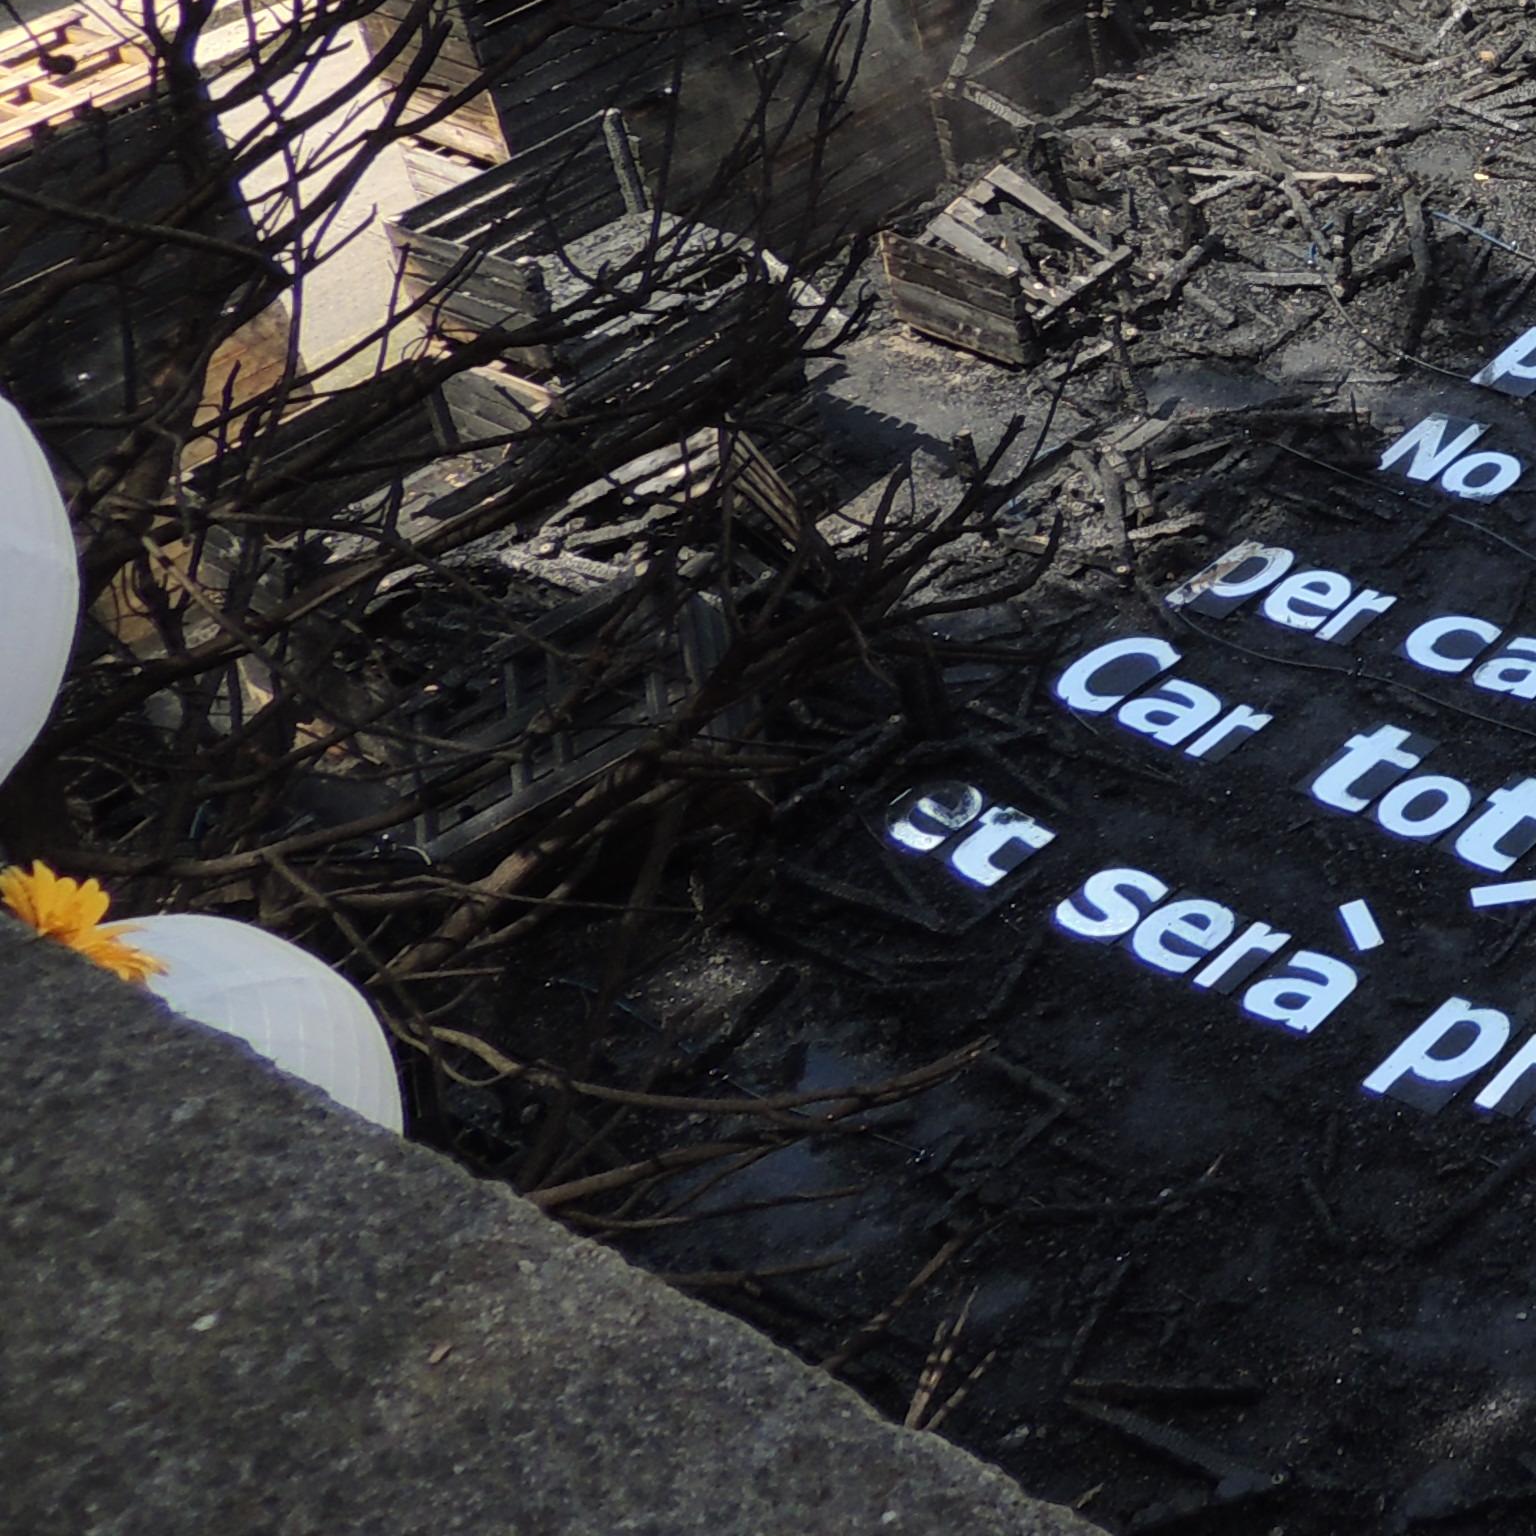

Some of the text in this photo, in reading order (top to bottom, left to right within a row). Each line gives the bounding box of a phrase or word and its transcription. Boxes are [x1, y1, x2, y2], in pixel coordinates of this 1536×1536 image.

[1378, 412, 1524, 501] No
[1166, 538, 1397, 642] per
[1055, 636, 1273, 758] Car
[886, 780, 1057, 887] et
[1054, 868, 1384, 1034] serà
